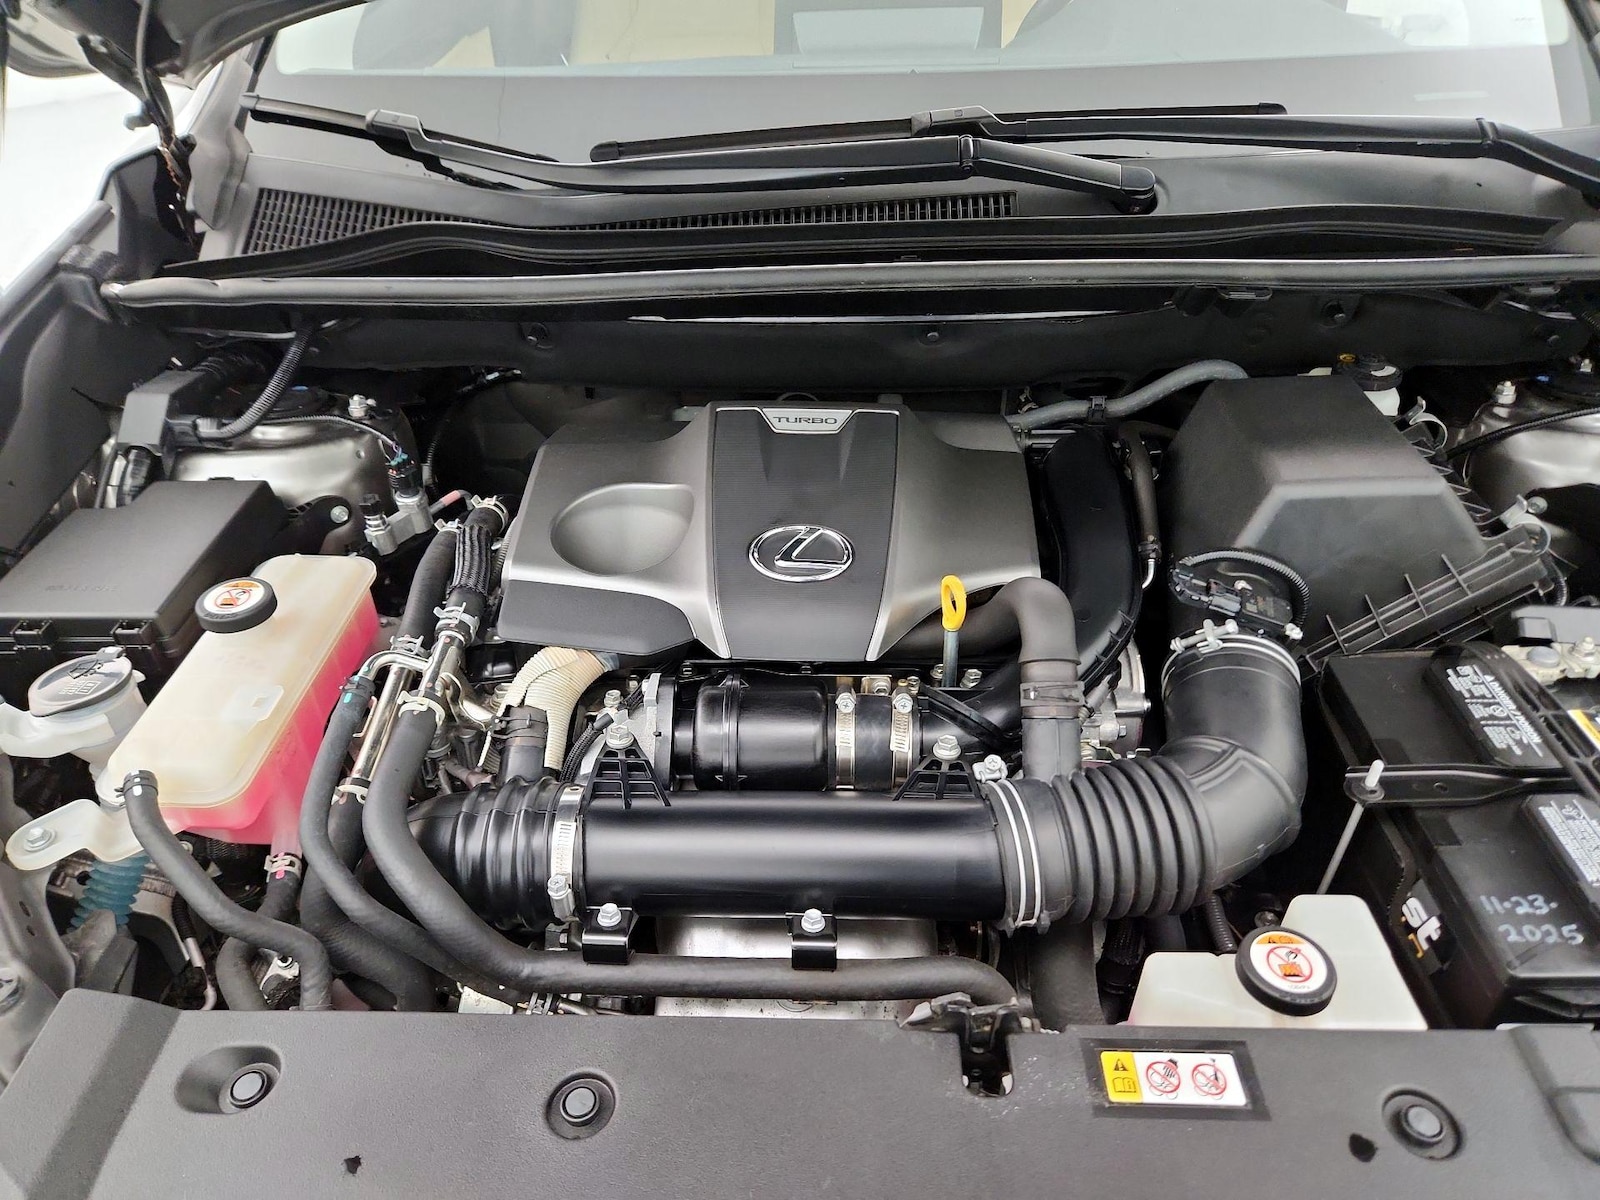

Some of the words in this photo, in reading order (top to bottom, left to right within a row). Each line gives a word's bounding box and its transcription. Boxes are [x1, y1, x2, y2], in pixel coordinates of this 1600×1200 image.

[772, 416, 838, 425] TURBO
[1488, 681, 1517, 710] DANGER
[1514, 715, 1543, 743] POISON
[1498, 923, 1585, 946] 2025
